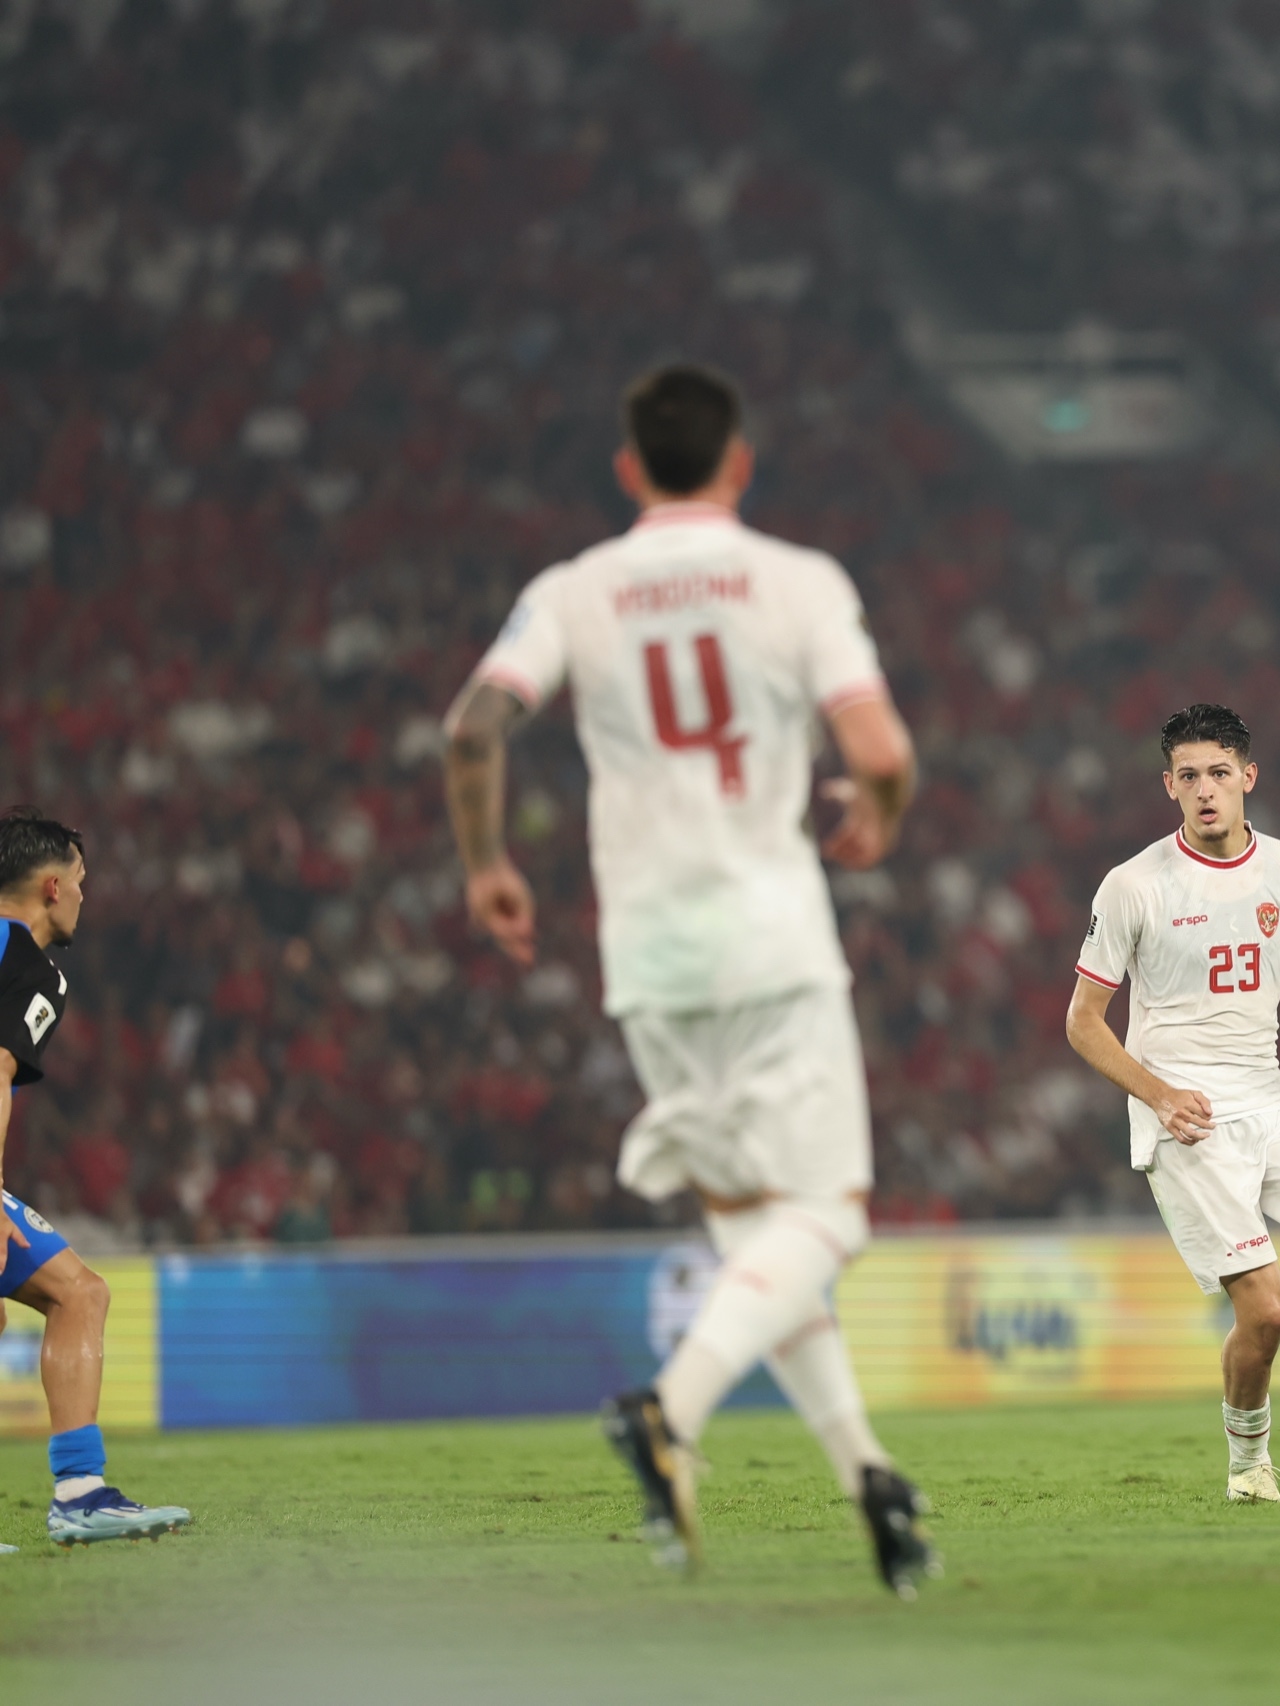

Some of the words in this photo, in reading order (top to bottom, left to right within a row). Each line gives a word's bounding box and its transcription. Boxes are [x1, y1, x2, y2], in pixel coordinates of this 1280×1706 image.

[643, 632, 748, 801] 4
[1172, 914, 1208, 927] erspo
[1208, 943, 1260, 994] 23
[1235, 1234, 1269, 1251] erspo
